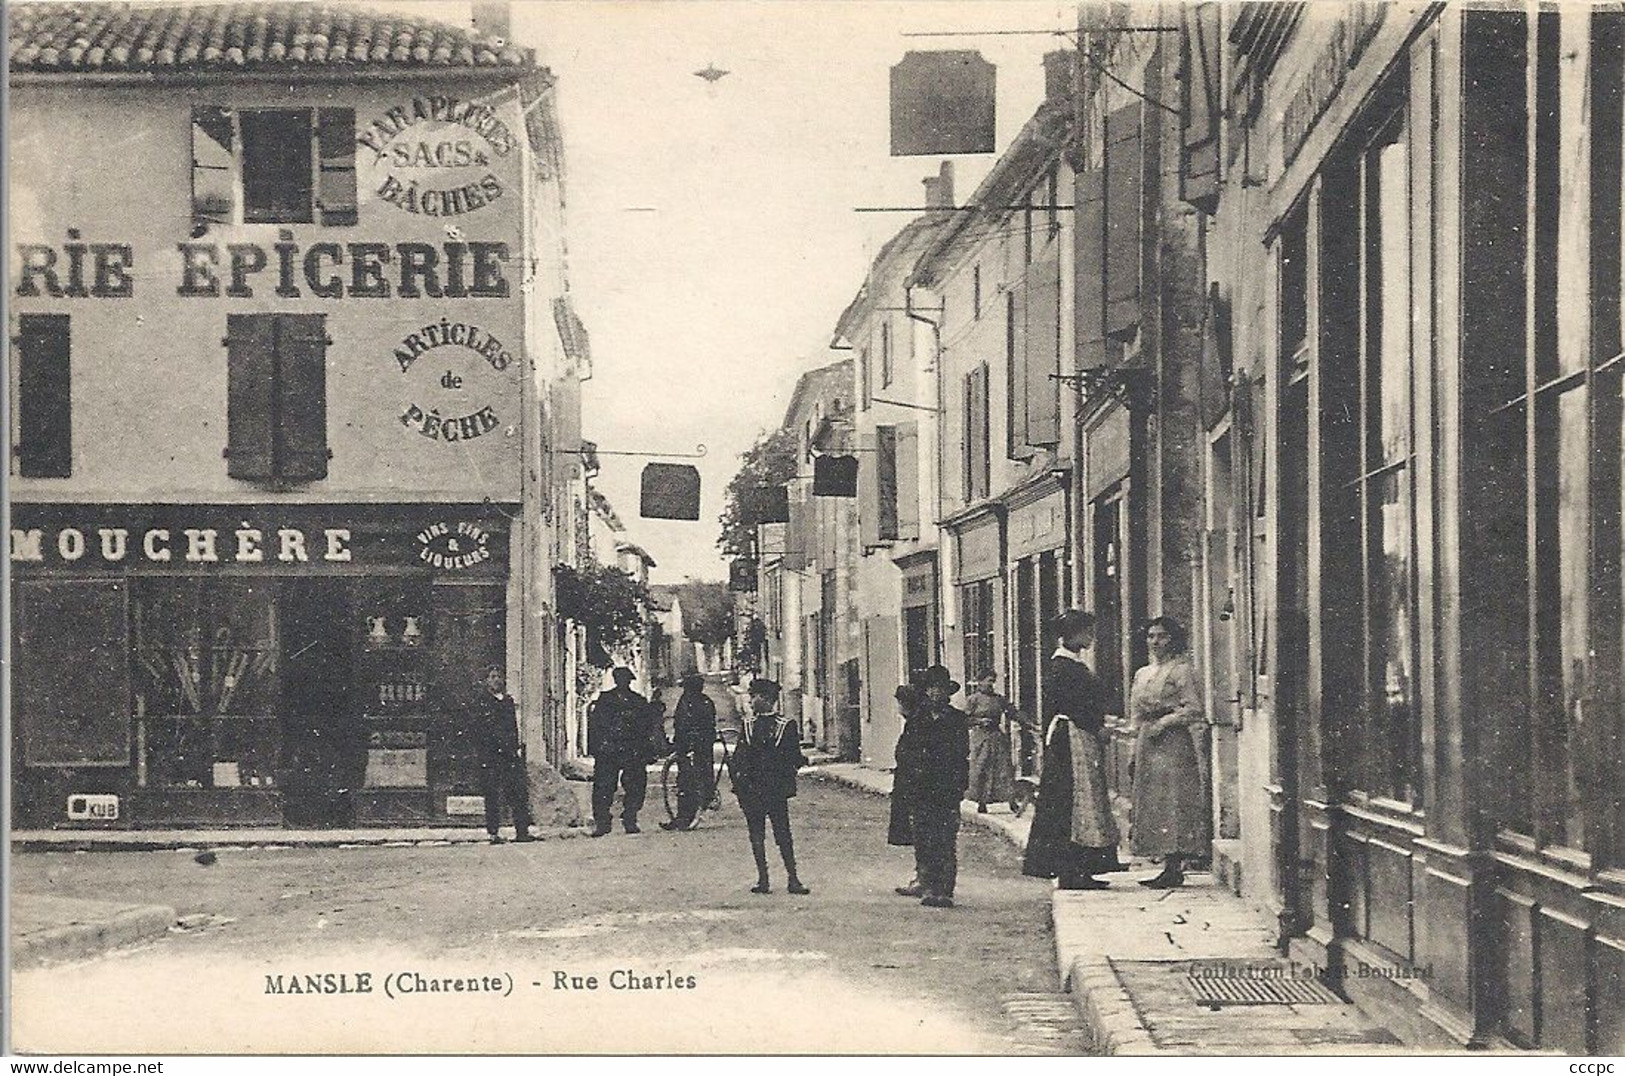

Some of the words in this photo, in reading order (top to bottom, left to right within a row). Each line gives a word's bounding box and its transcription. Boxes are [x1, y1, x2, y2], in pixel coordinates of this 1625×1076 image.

[393, 140, 473, 168] SACS
[377, 174, 503, 217] BÂCHES
[16, 228, 133, 298] RIE
[177, 228, 511, 299] ÉPICERIE
[393, 317, 513, 373] ARTICLES
[440, 370, 463, 389] de
[398, 403, 500, 442] PÊCHE
[10, 521, 351, 562] MOUCHÈRE
[416, 522, 449, 544] VINS
[458, 521, 490, 544] FINS
[447, 538, 460, 552] &
[420, 546, 490, 570] LIQUEURS
[88, 803, 116, 818] KUB
